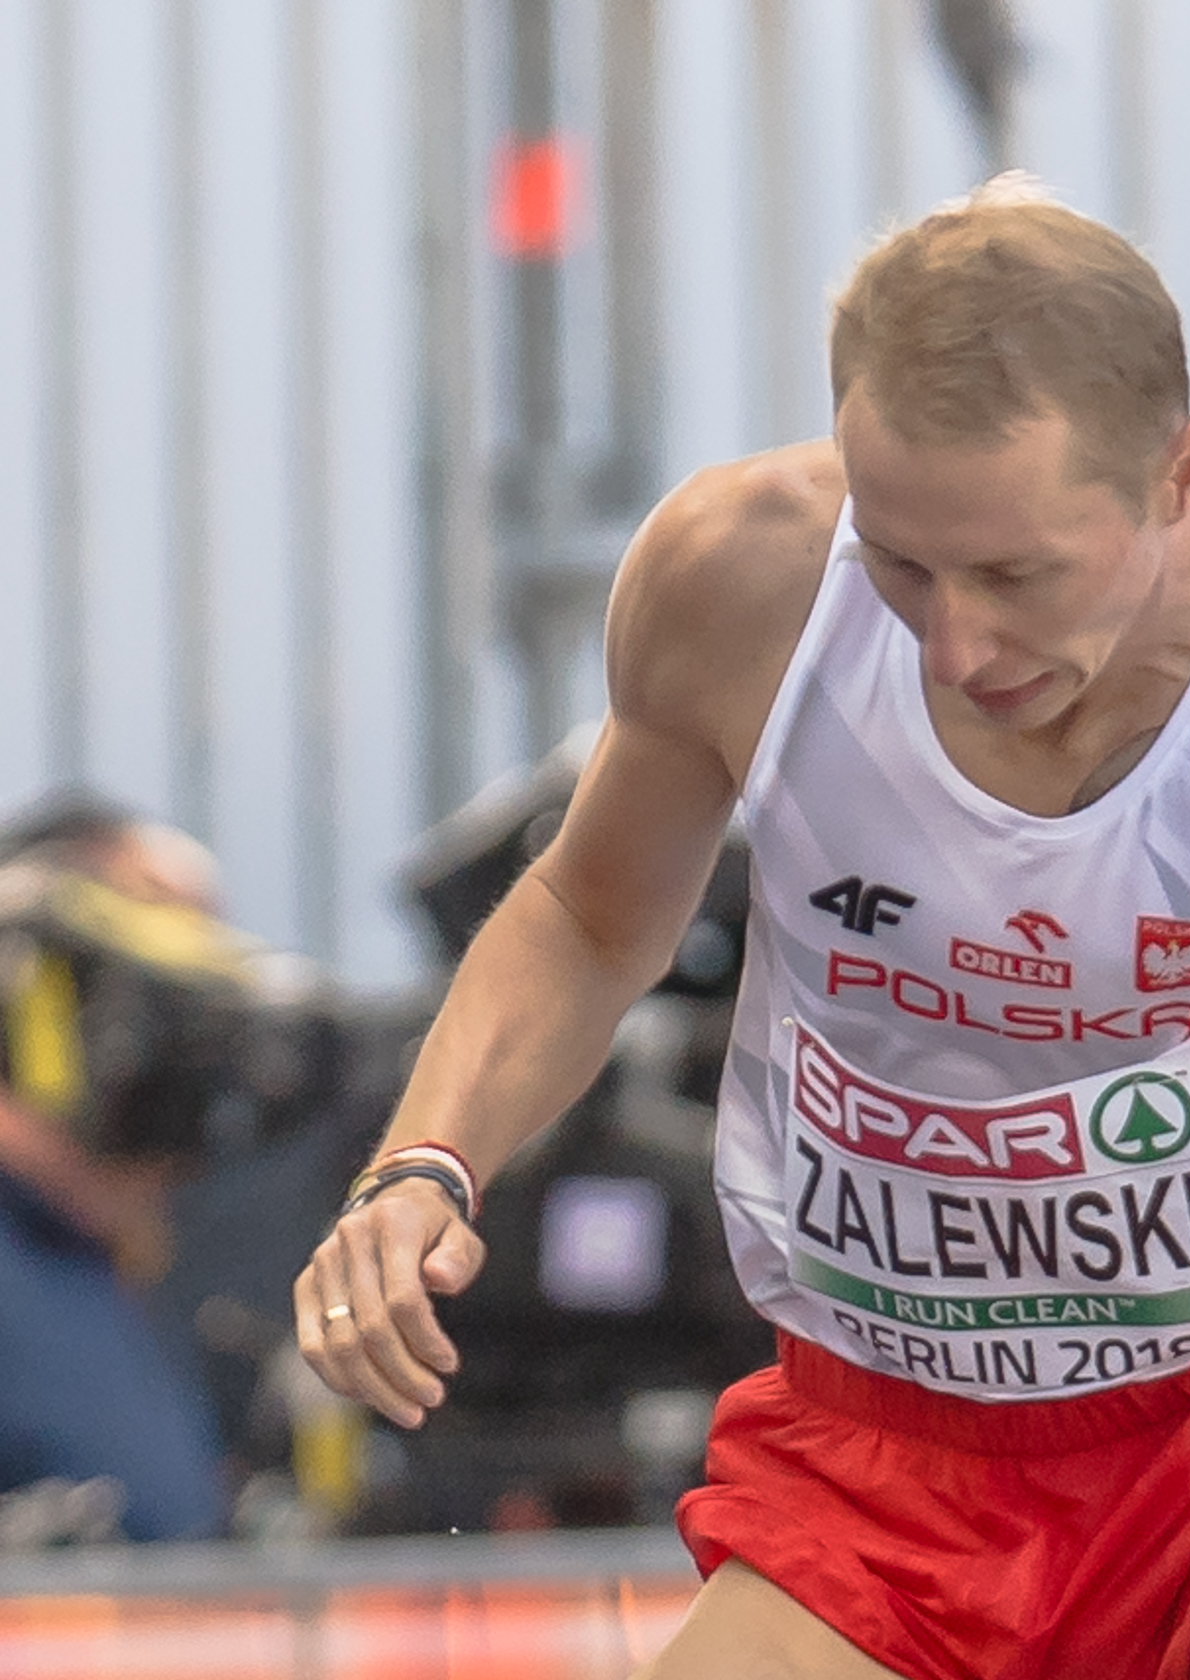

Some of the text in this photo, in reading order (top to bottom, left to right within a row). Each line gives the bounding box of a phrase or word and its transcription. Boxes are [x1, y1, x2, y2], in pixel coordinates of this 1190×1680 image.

[808, 875, 918, 936] 4F
[955, 946, 1064, 985] ORLEN
[799, 1045, 1074, 1169] SPAR
[873, 1287, 885, 1312] I
[894, 1294, 977, 1326] RUN
